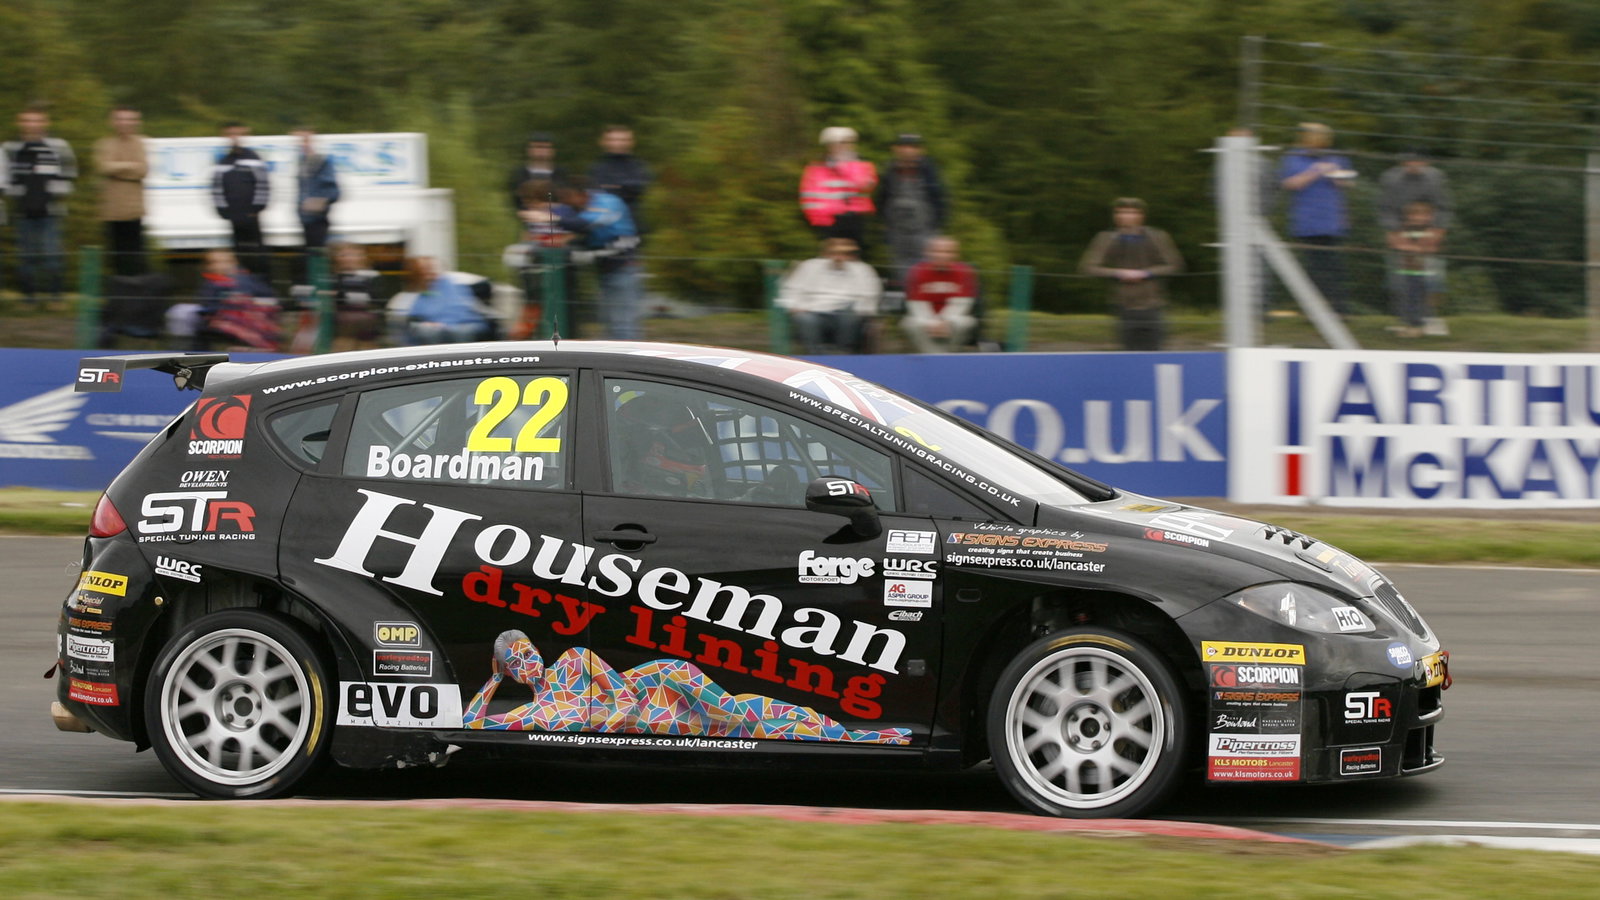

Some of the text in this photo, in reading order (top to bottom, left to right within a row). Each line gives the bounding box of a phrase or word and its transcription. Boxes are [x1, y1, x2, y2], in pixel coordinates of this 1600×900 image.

[78, 368, 119, 383] STR
[263, 356, 540, 394] www.scorpion-exhausts.com
[468, 376, 568, 453] 22
[188, 440, 243, 455] SCORPION
[789, 391, 1021, 507] WWW.SPECIALTUNINGRACING.CO.UK
[367, 445, 544, 481] Boardman
[181, 470, 230, 483] OWEN
[826, 480, 870, 496] STR
[138, 491, 256, 533] STR
[139, 533, 256, 543] SPECIAL TUNING RACING
[1016, 527, 1067, 537] graphics
[1070, 532, 1085, 540] by
[1164, 531, 1209, 547] SCORPION
[962, 533, 1109, 553] SIGNS EXPRESS
[968, 547, 996, 555] creating
[997, 548, 1014, 556] signs
[156, 555, 202, 577] WRC
[883, 558, 937, 573] WRC
[946, 552, 1106, 573] signsexpress.co.uk/lancaster
[81, 575, 124, 589] NLOP
[313, 488, 906, 675] Houseman
[888, 584, 906, 593] AG
[462, 564, 605, 635] dry
[1335, 609, 1364, 626] HiQ
[378, 626, 418, 641] OMP
[1222, 647, 1300, 658] DUNLOP
[379, 664, 427, 672] Racing Batteries
[625, 605, 887, 720] lining
[1238, 666, 1299, 684] SCORPION
[347, 684, 438, 719] evo
[1344, 692, 1392, 719] STR
[528, 733, 758, 750] www.signsexpress.co.uk/lancaster
[1216, 737, 1297, 752] Pipercross
[1214, 770, 1293, 778] www.klsmotors.co.uk
